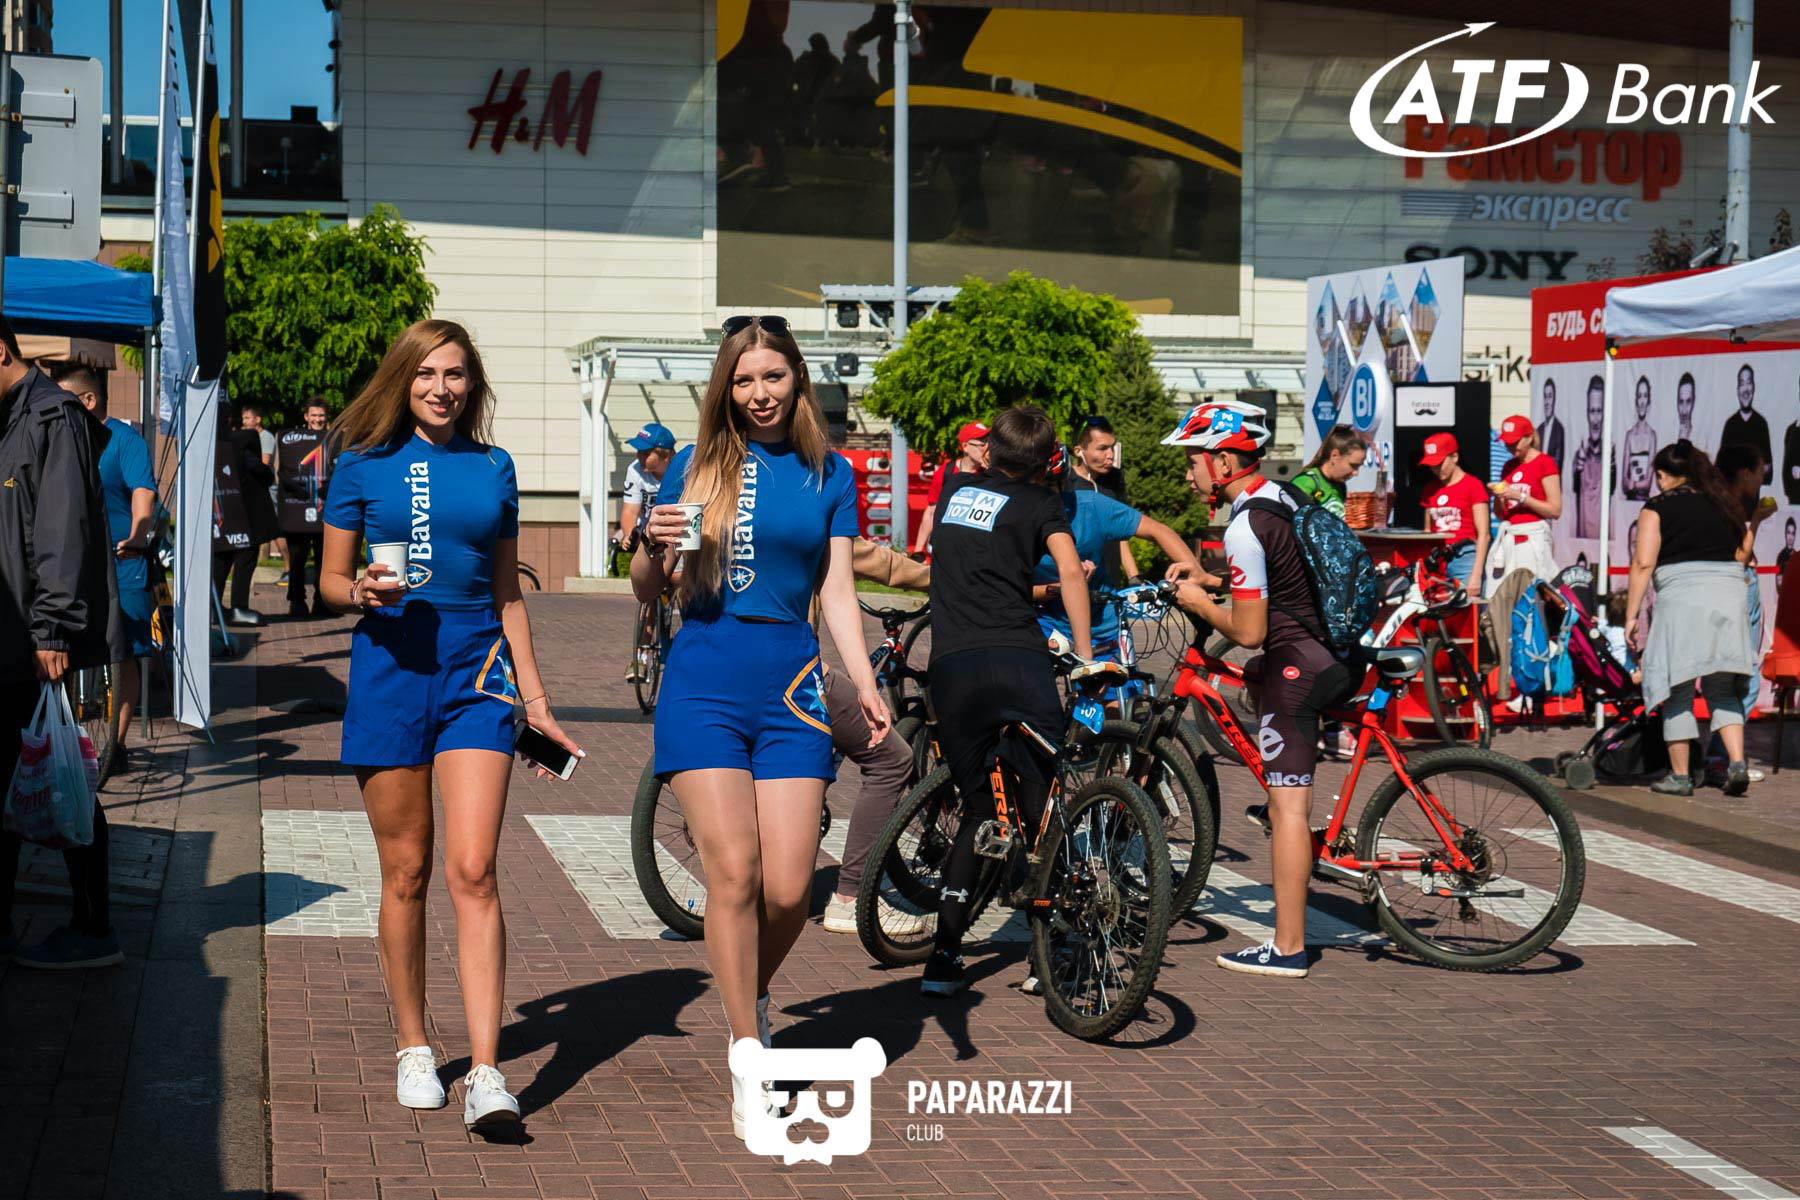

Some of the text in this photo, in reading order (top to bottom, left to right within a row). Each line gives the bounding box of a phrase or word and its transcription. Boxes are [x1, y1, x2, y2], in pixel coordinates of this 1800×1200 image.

[467, 67, 603, 157] H&M
[1471, 193, 1633, 231] экспресс
[1546, 309, 1586, 341] БУДЬ
[1356, 378, 1373, 418] BI
[404, 460, 432, 561] Bavaria
[948, 505, 992, 523] 107 107
[226, 533, 249, 544] VISA
